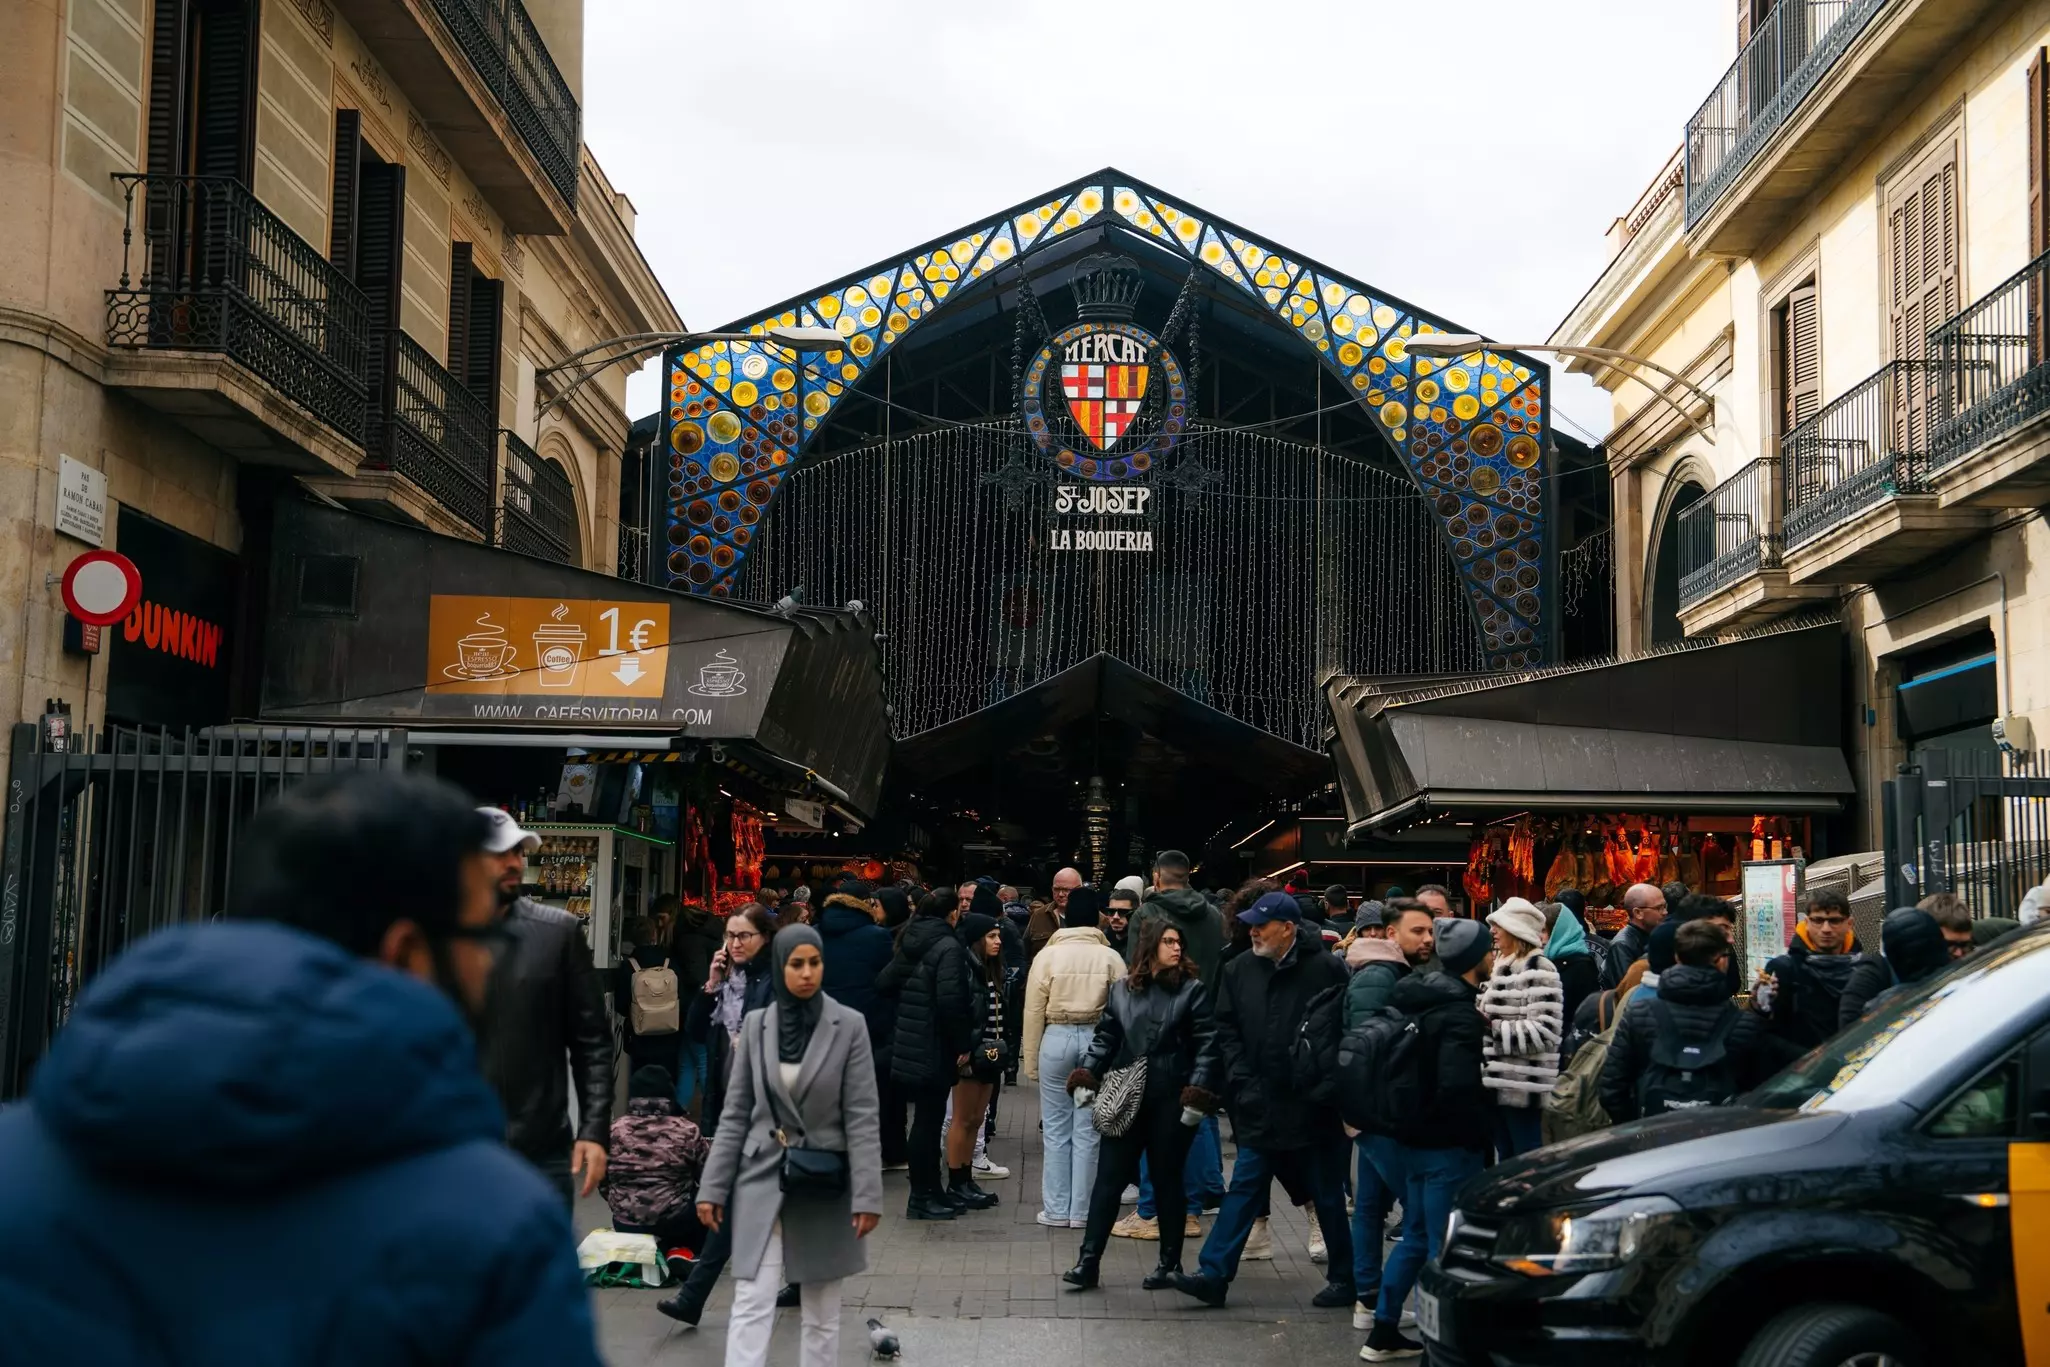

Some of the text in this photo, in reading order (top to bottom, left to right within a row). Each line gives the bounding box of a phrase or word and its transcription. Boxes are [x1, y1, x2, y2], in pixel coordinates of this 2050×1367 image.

[1064, 333, 1147, 362] MERCAT
[63, 487, 84, 504] RAMON
[1077, 486, 1150, 513] JOSEP
[1051, 530, 1153, 551] LA BOQUERIA
[546, 654, 570, 664] Coffee
[672, 708, 712, 725] COM
